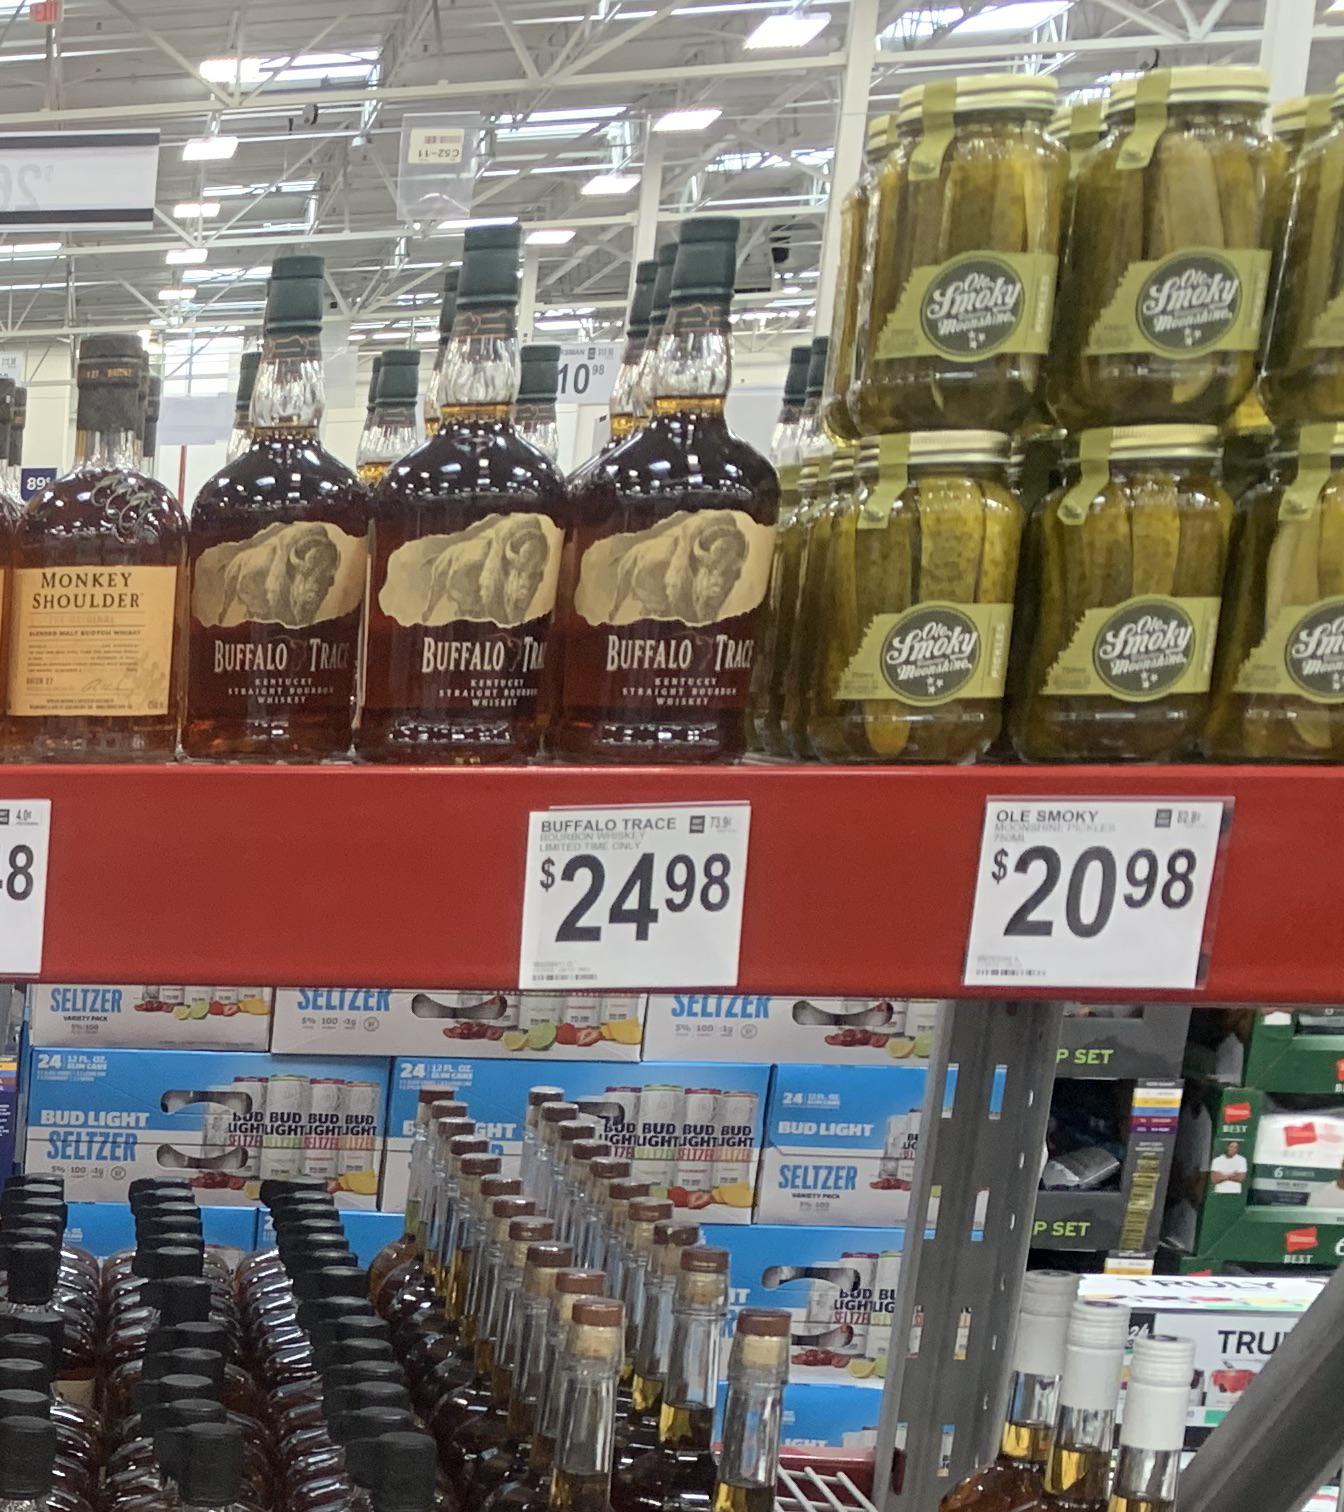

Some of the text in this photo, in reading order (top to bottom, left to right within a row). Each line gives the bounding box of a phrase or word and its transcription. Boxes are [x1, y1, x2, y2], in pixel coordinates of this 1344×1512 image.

[926, 277, 1021, 320] Smoky
[541, 818, 676, 832] BUFFALO TRACE
[997, 810, 1098, 824] OLE SMOKY
[38, 1054, 62, 1069] 24
[1074, 1048, 1114, 1065] SET
[41, 1109, 150, 1129] BUD LIGHT
